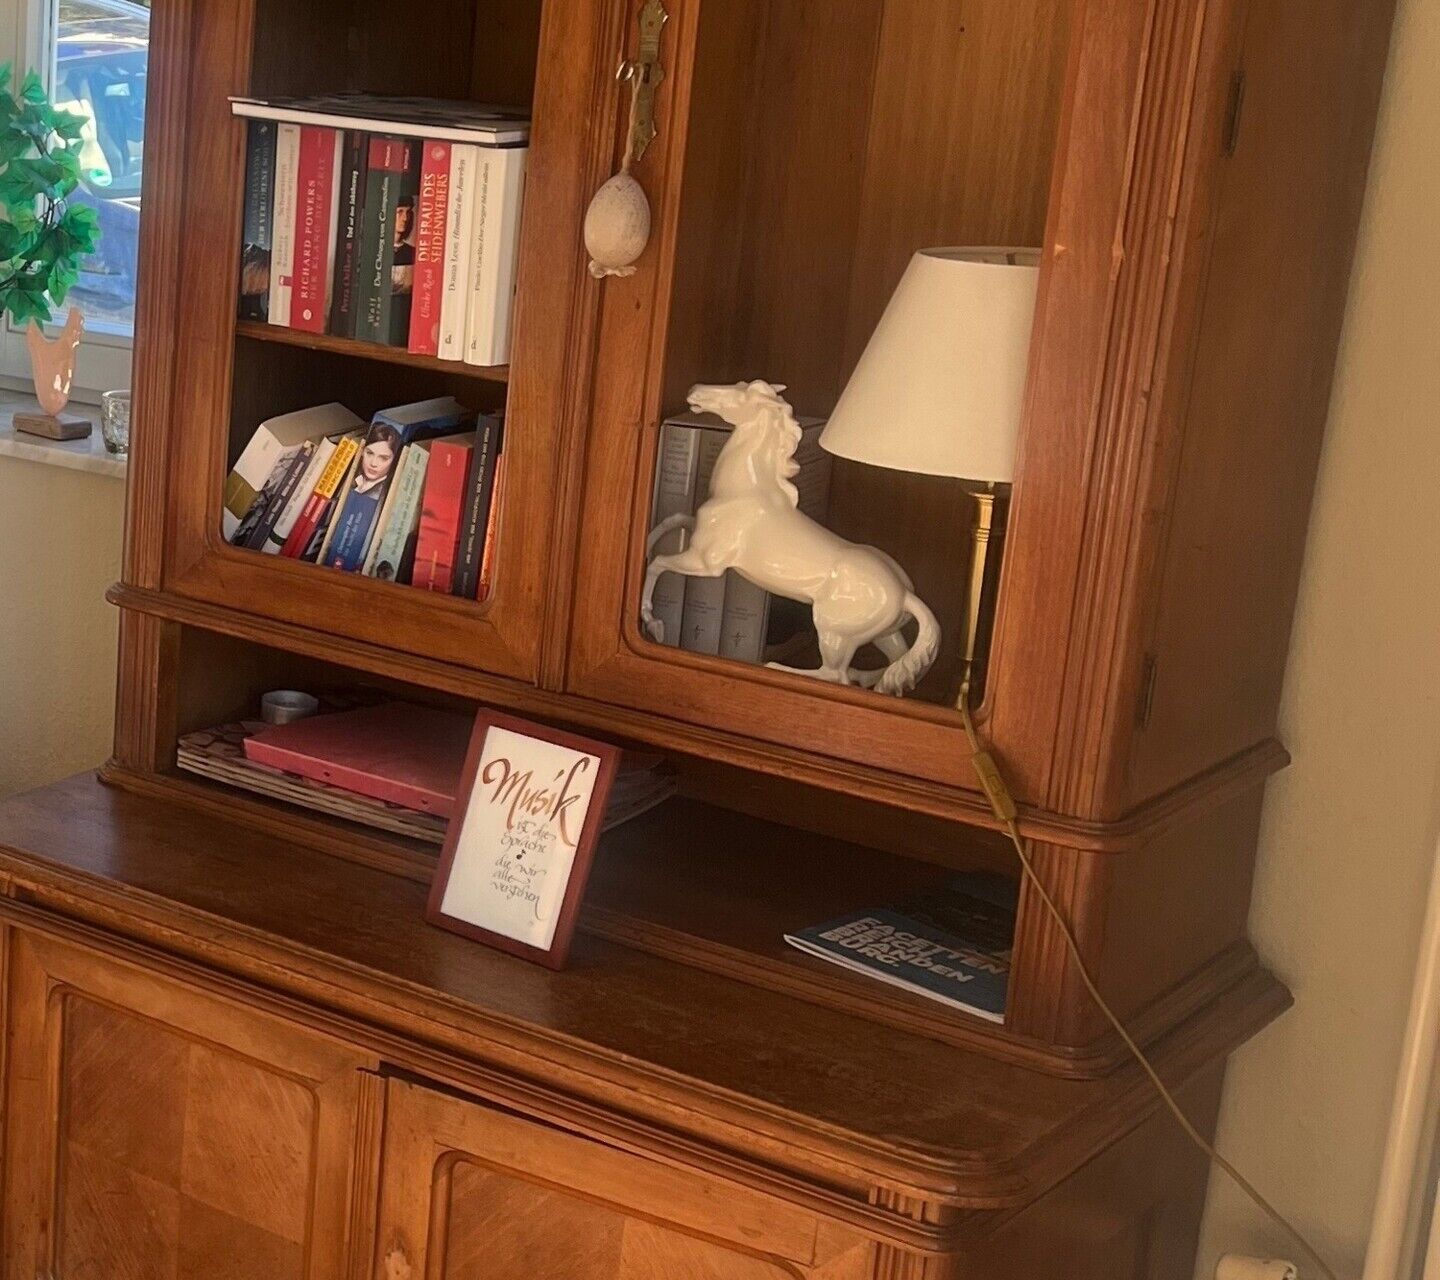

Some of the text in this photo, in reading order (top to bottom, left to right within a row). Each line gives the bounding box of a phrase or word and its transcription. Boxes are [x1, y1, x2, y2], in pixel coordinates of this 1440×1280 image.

[300, 179, 316, 298] RICHARD POWERS
[345, 226, 354, 238] Tod
[417, 172, 435, 262] DIE FRAU DES
[430, 173, 448, 263] SEIDENWEBERS
[450, 241, 459, 262] Leon
[448, 264, 458, 291] Donna
[314, 439, 350, 490] MARCO POLO
[322, 443, 356, 494] MARCO POLO
[482, 756, 591, 847] Musik
[501, 832, 547, 854] Sprache
[516, 818, 557, 840] ist die
[492, 870, 531, 884] alle
[495, 858, 547, 876] die wir
[830, 926, 975, 983] BRANDEN
[856, 916, 1005, 975] FACETTEN
